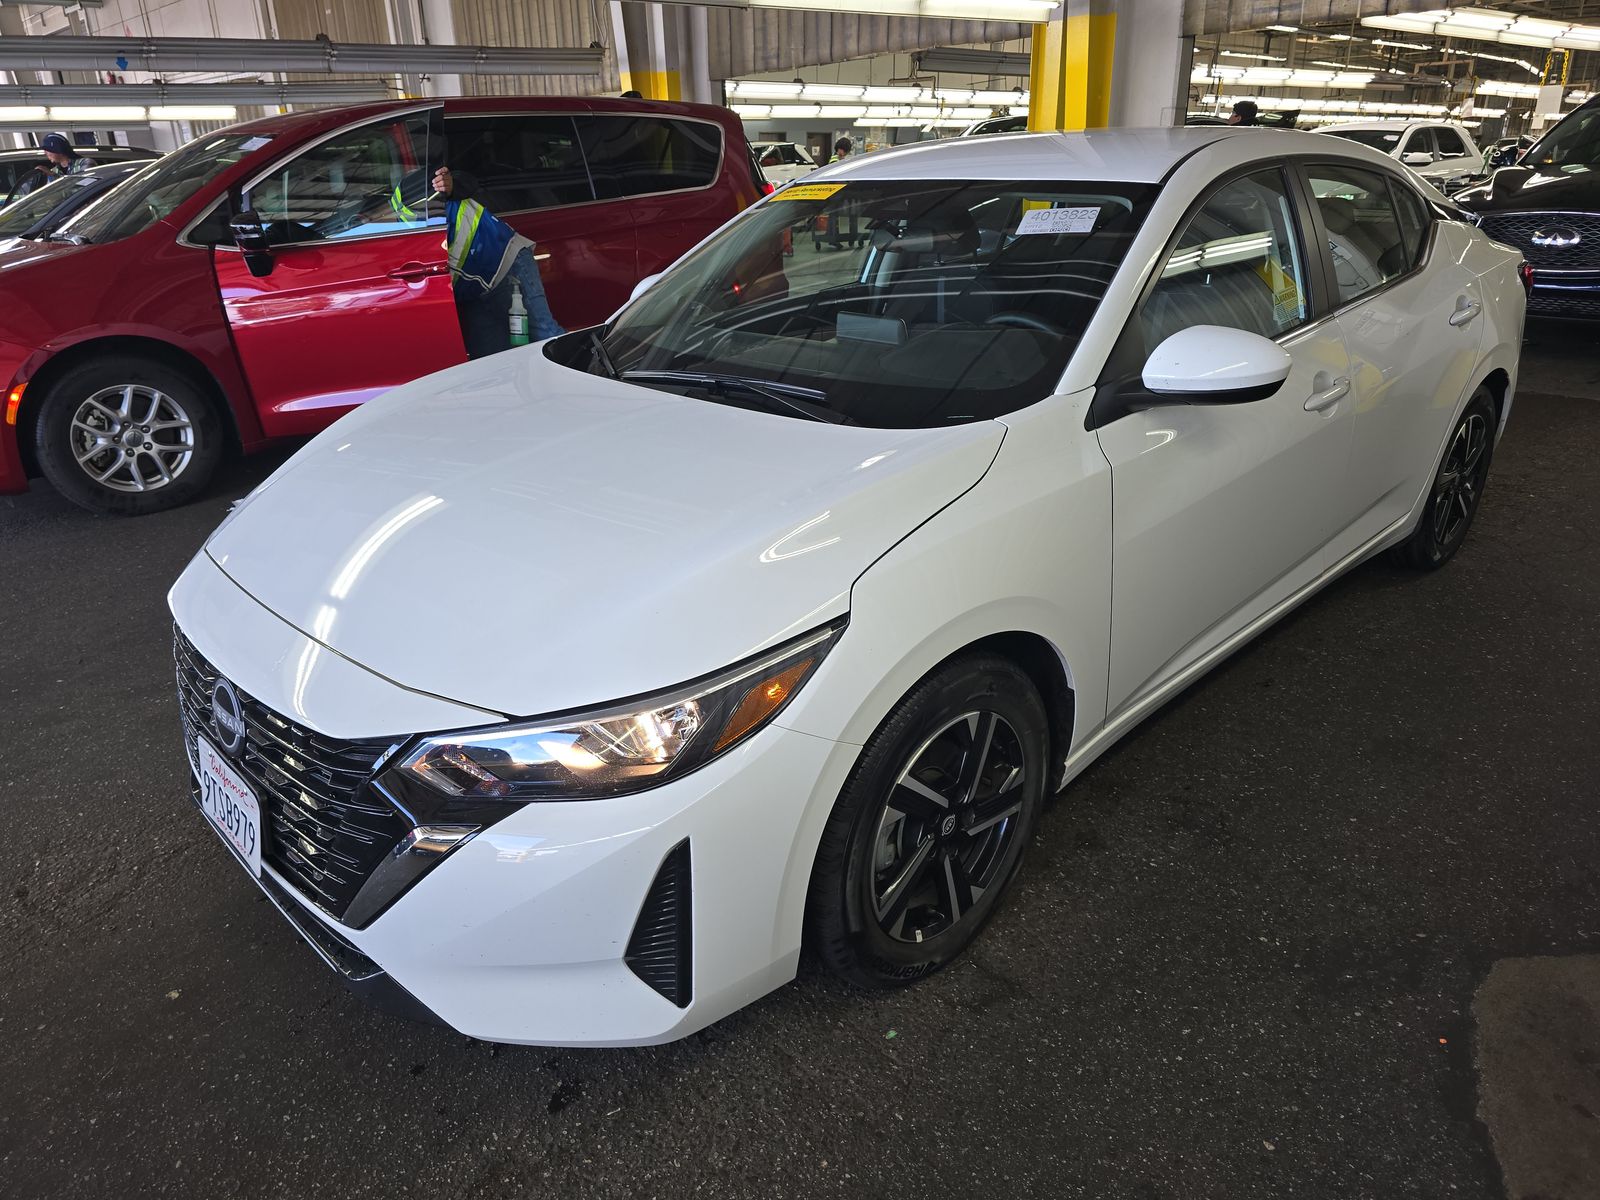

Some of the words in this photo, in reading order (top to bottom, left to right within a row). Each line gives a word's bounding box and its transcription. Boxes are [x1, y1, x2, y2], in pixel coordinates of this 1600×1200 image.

[1030, 209, 1098, 221] 4013823
[213, 702, 243, 735] SSAN
[210, 756, 249, 799] California
[203, 770, 256, 856] 9TSB979
